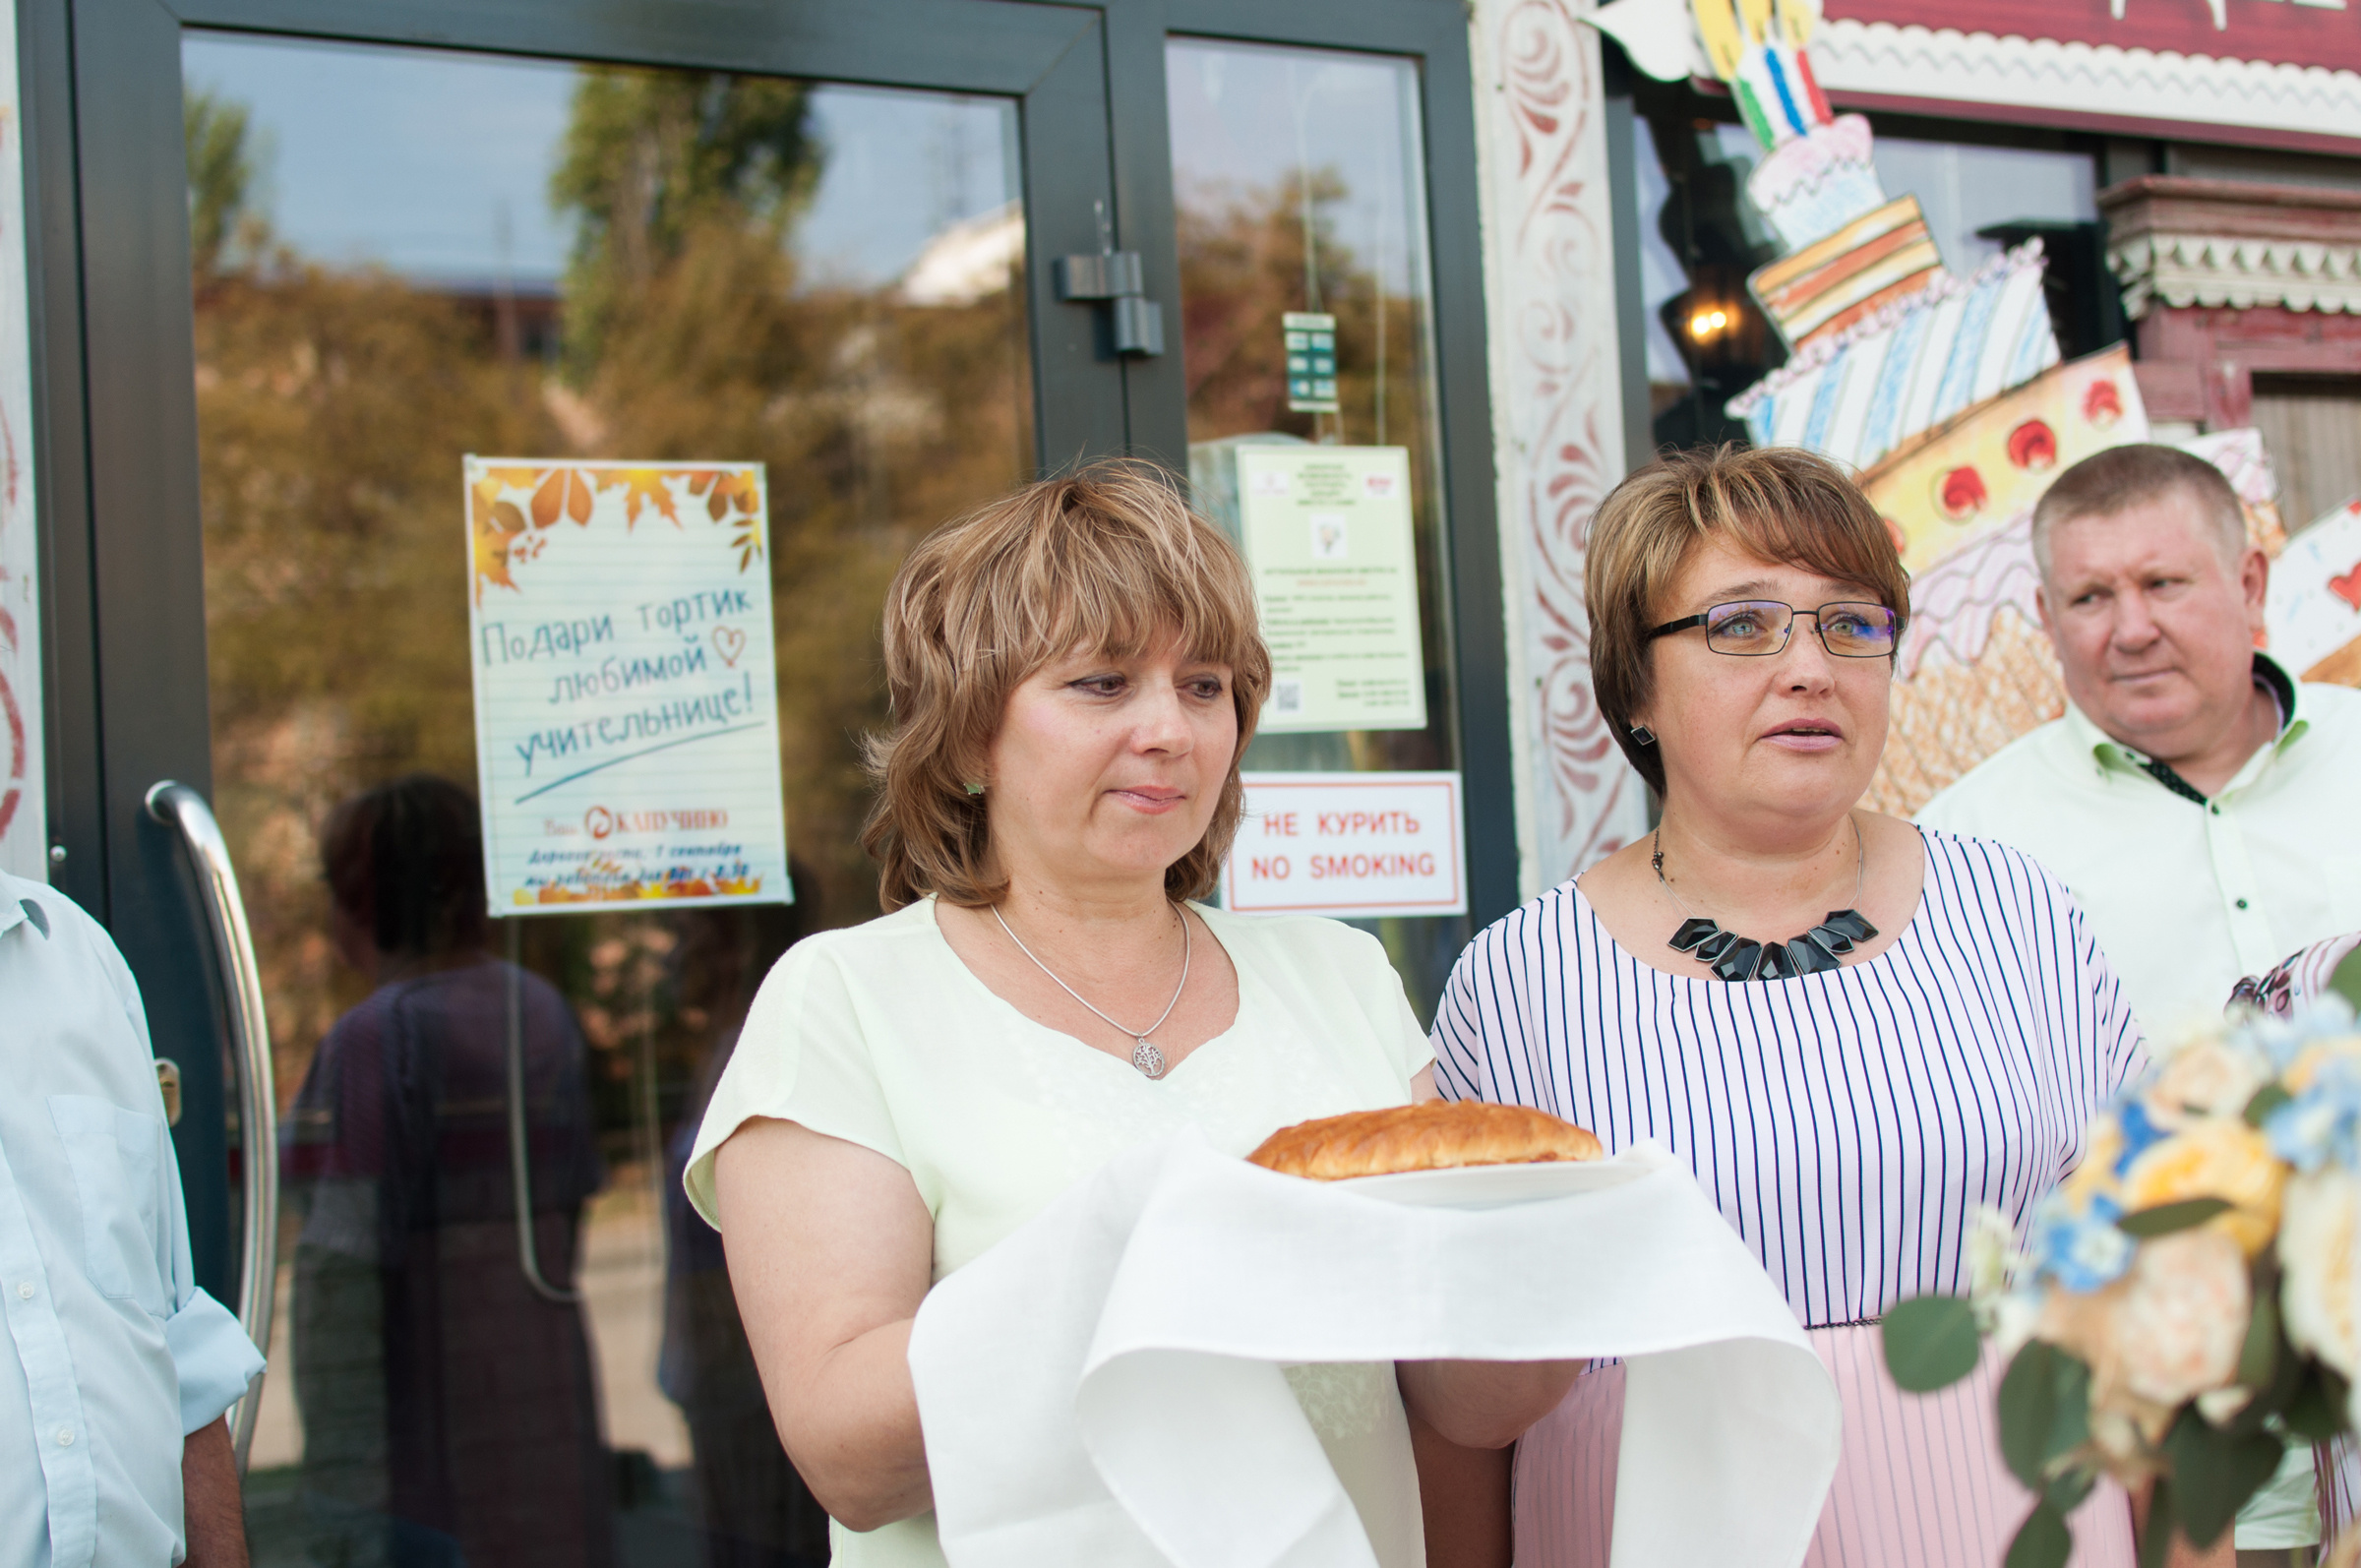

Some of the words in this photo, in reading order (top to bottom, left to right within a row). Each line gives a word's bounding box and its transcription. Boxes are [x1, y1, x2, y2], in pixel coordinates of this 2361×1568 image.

[481, 614, 614, 667] Подари
[547, 633, 707, 705] любимой
[514, 669, 754, 778] учительнице!
[1263, 813, 1299, 836] НЕ
[1318, 811, 1421, 835] КУРИТЬ
[1251, 855, 1291, 880] NO
[1309, 852, 1436, 880] SMOKING
